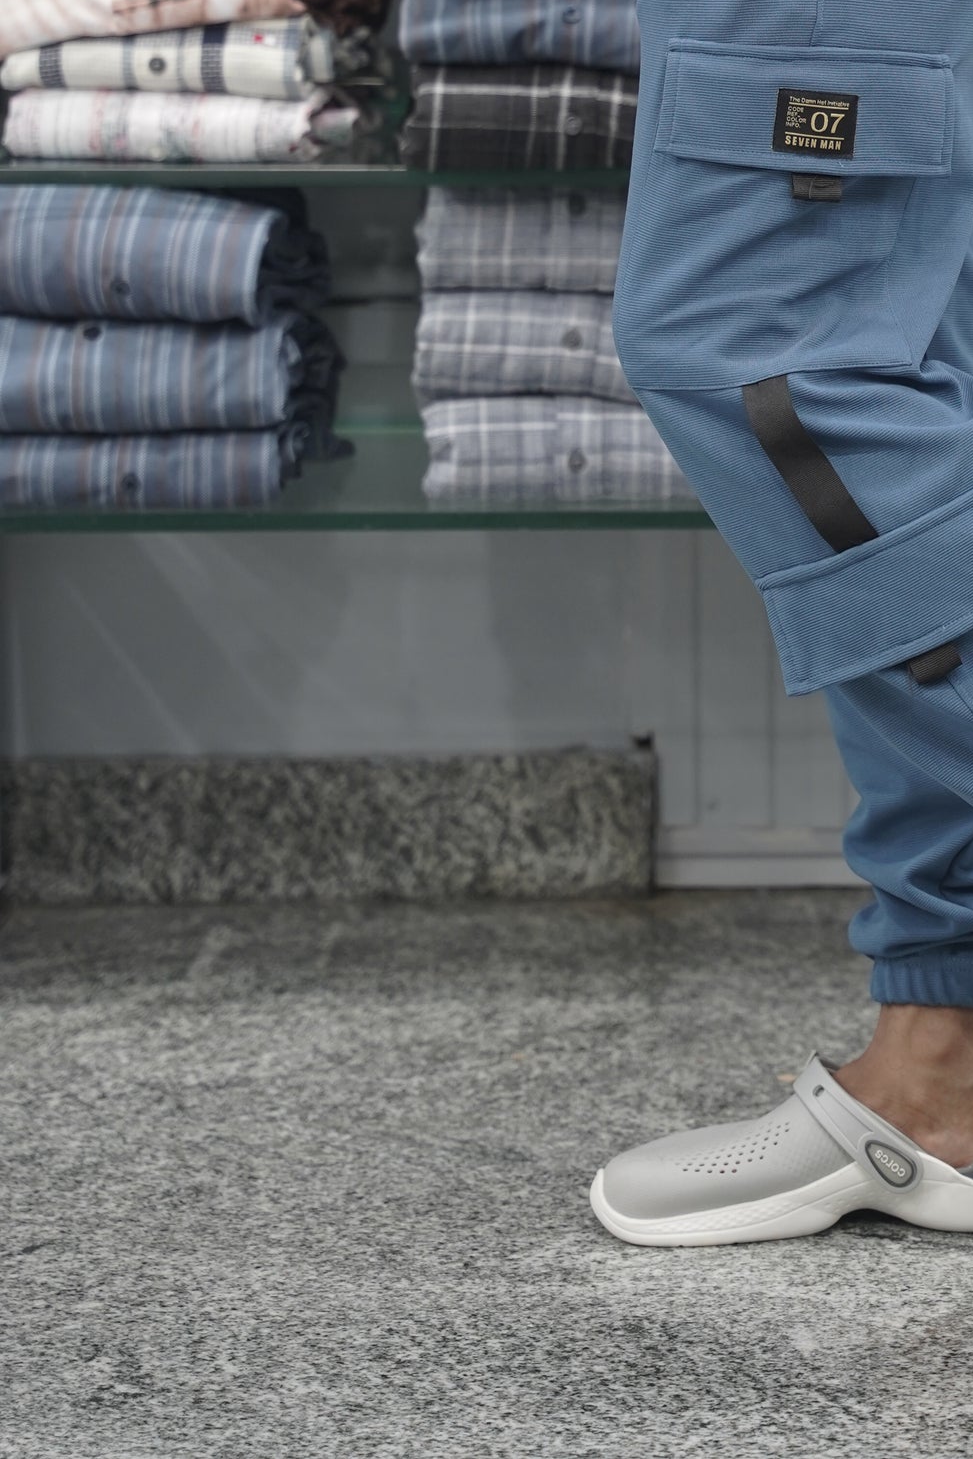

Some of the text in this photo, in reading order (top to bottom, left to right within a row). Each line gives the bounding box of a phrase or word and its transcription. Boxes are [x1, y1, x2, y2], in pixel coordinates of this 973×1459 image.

[786, 116, 807, 124] COLOR
[810, 111, 845, 134] 07
[785, 136, 841, 150] SEVEN MAN
